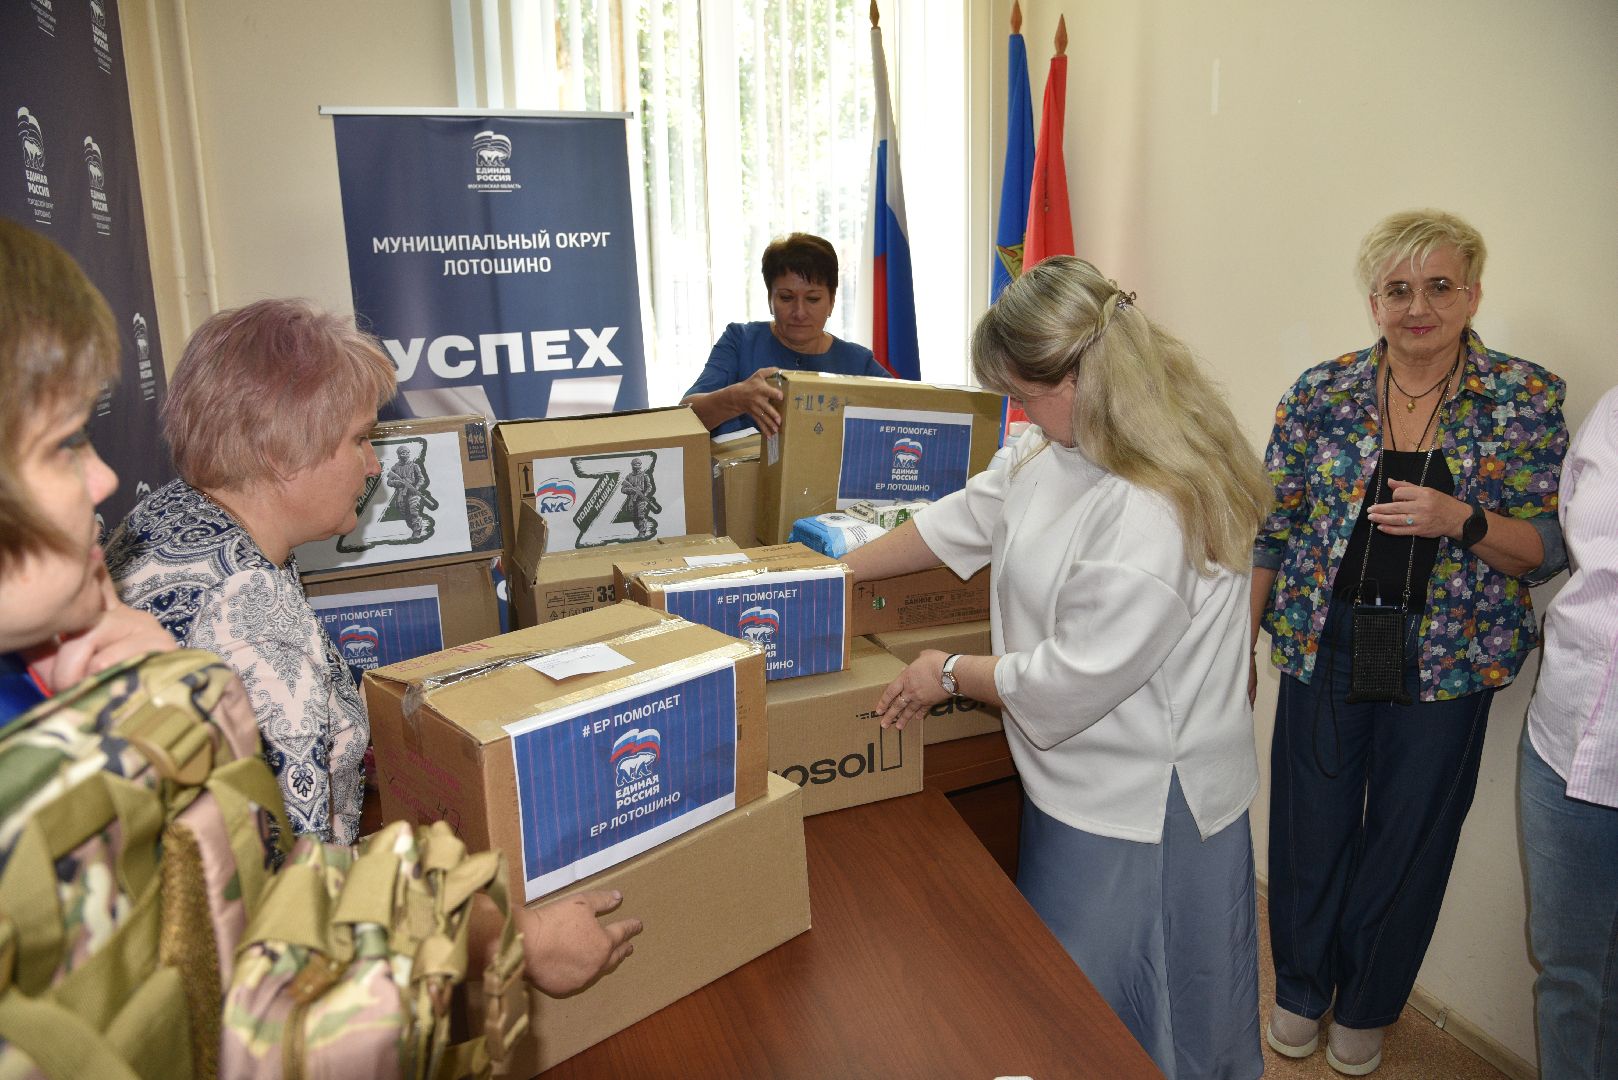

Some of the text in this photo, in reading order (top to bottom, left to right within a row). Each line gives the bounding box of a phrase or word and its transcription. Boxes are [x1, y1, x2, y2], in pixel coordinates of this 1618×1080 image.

[372, 229, 611, 254] МУНИЦИПАЛЬНЫЙ ОКРУГ
[443, 256, 552, 276] ЛОТОШИНО
[381, 326, 624, 383] УСПЕХ
[897, 427, 938, 436] ПОМОГАЕТ
[887, 483, 930, 492] ЛОТОШИНО
[742, 589, 798, 603] ПОМОГАЕТ
[340, 608, 393, 621] ПОМОГАЕТ
[614, 694, 680, 728] ПОМОГАЕТ
[773, 742, 875, 788] osol
[615, 774, 660, 799] ЕДИНАЯ
[616, 784, 660, 810] РОССИЯ
[590, 791, 681, 838] ЕР ЛОТОШИНО
